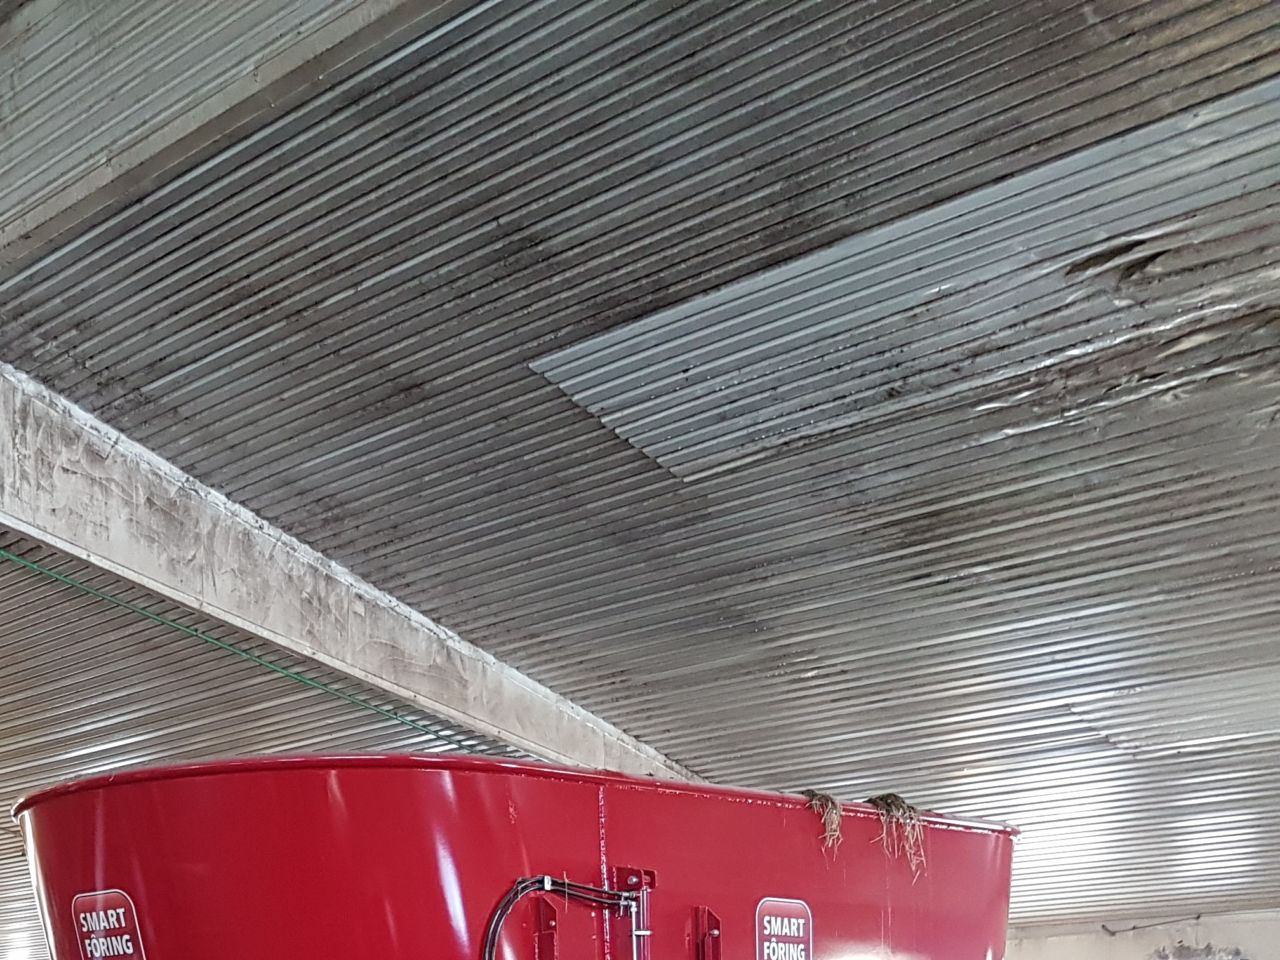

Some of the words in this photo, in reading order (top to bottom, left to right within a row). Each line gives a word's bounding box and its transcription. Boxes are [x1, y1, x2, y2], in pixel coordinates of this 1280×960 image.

[79, 908, 126, 932] SMART
[763, 915, 805, 937] SMART
[84, 934, 134, 958] FÔRING
